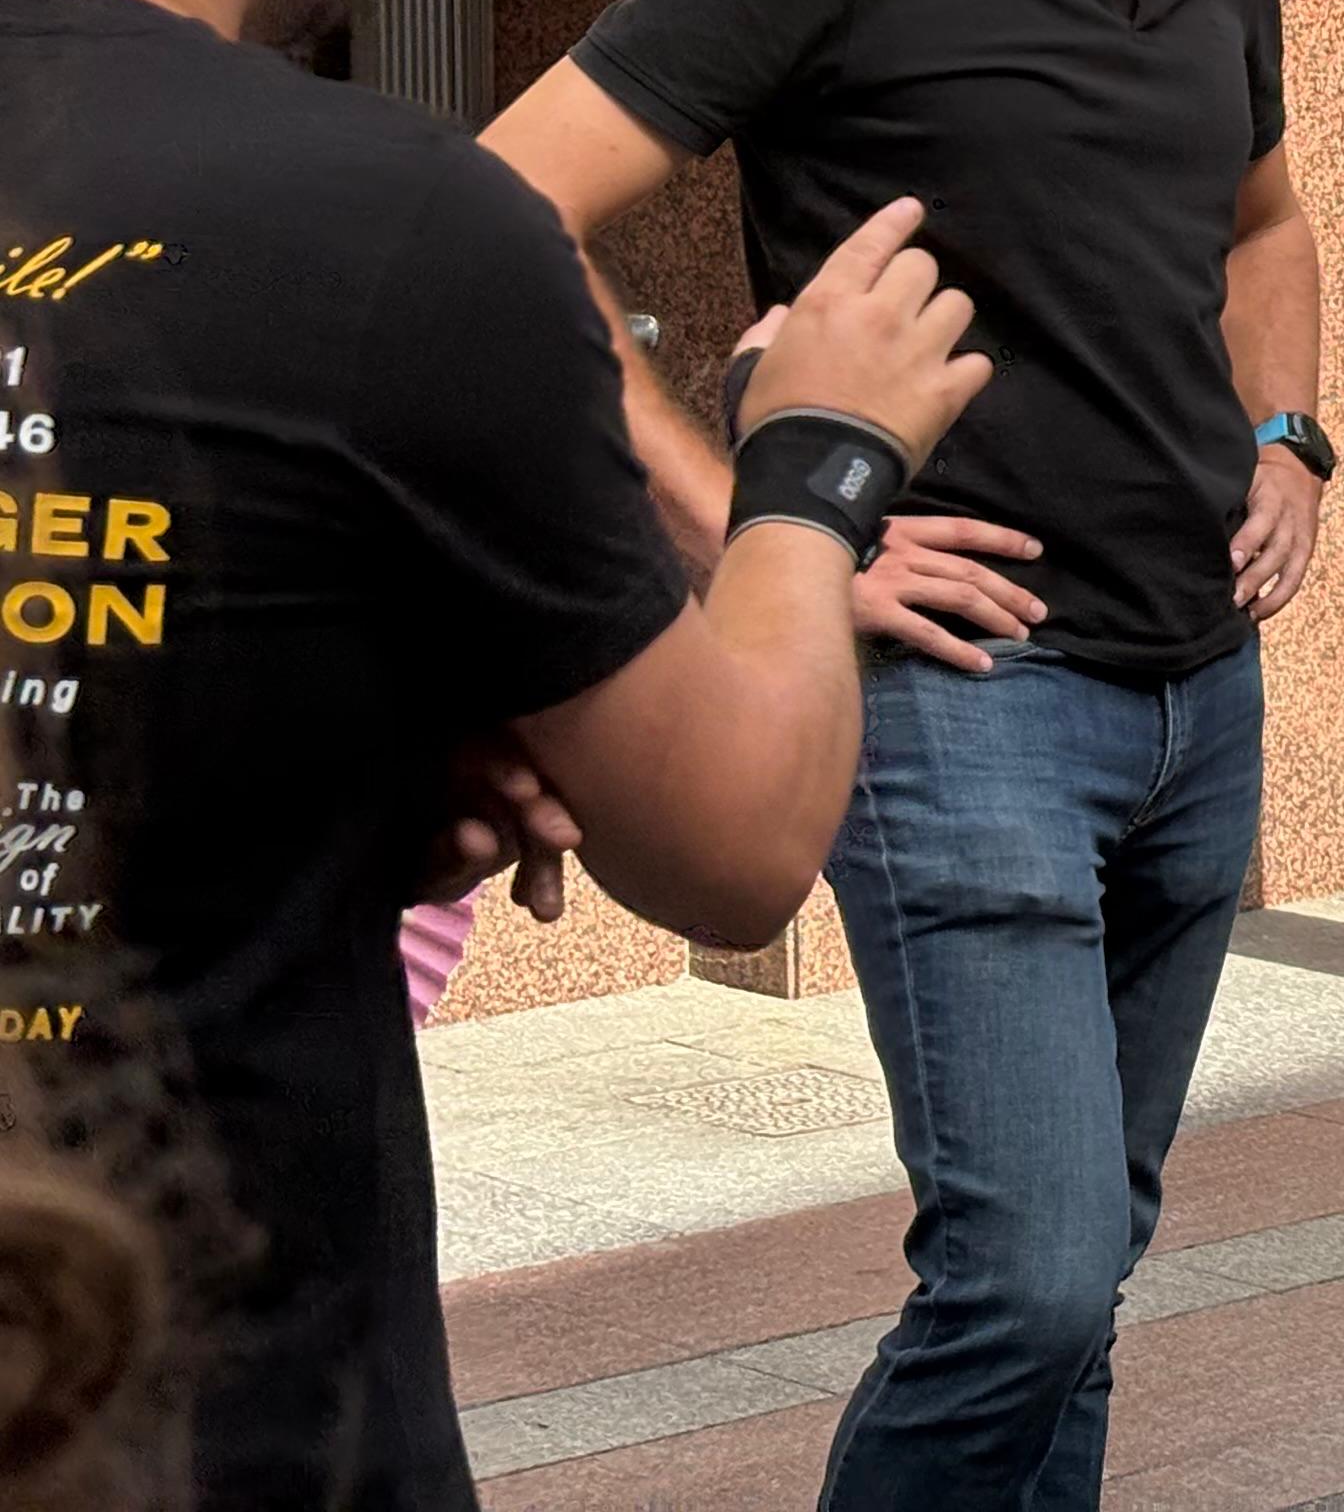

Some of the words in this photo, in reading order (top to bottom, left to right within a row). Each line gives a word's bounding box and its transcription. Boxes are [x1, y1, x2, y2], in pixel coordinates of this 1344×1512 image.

[2, 581, 166, 645] ON
[18, 782, 86, 811] The
[20, 863, 60, 896] of
[0, 1006, 83, 1041] DAY
